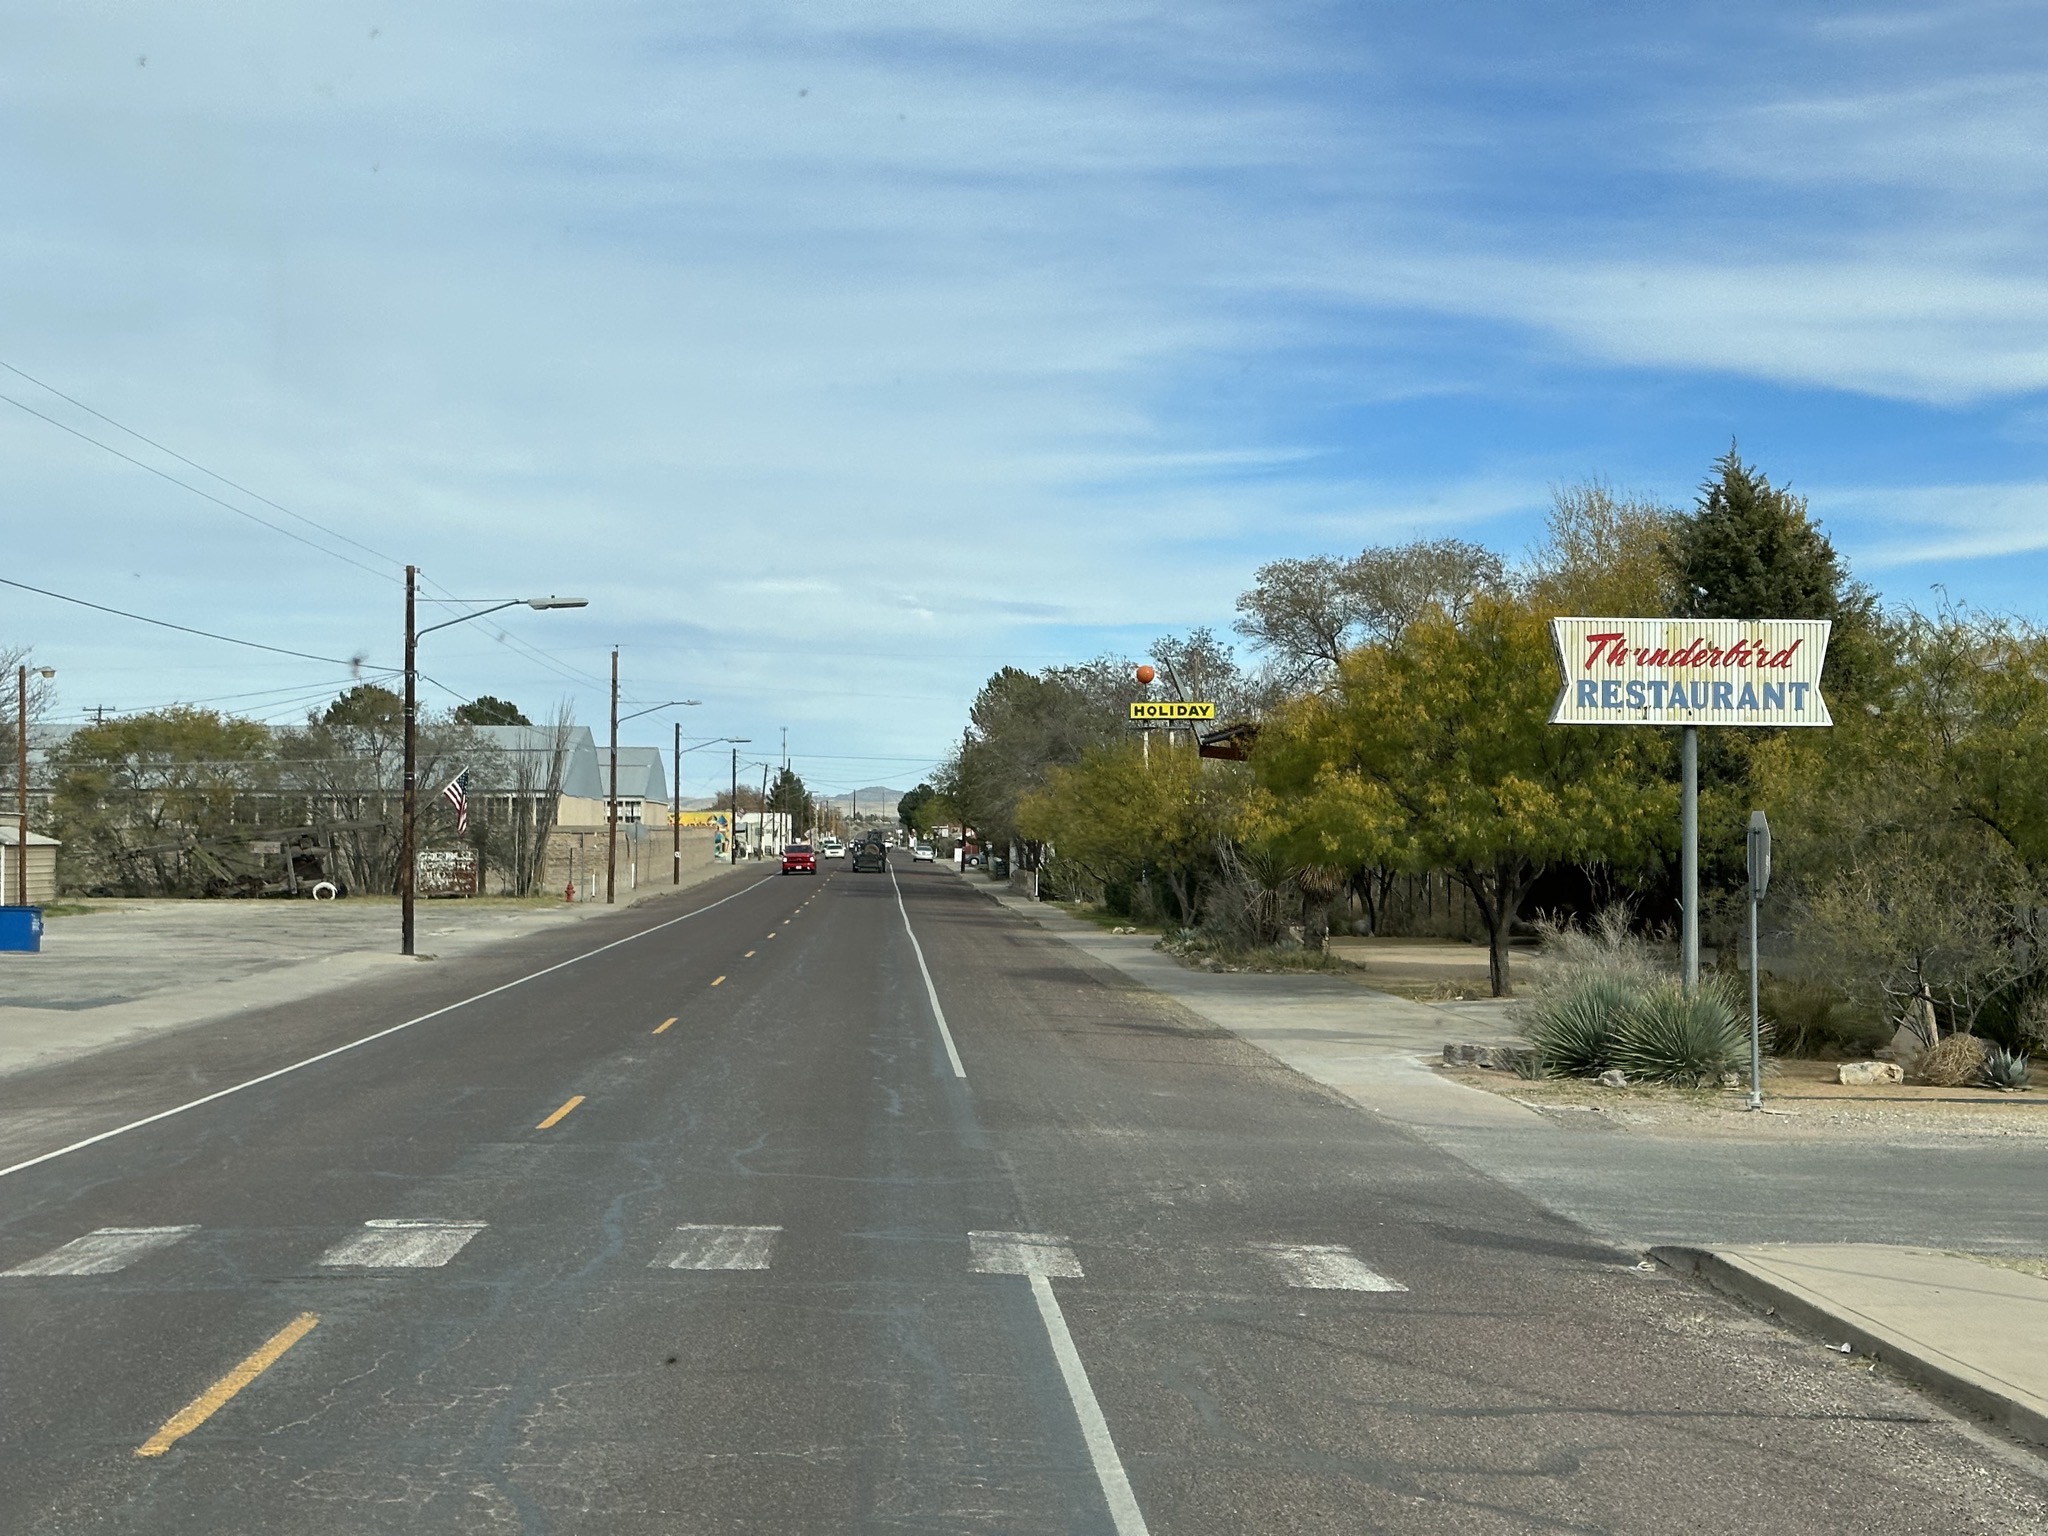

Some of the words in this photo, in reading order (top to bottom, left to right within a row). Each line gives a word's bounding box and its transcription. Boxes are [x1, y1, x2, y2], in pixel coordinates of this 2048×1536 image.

[1586, 633, 1803, 669] Thunderbird
[1576, 680, 1809, 710] RESTAURANT
[1134, 706, 1210, 716] HOLIDAY
